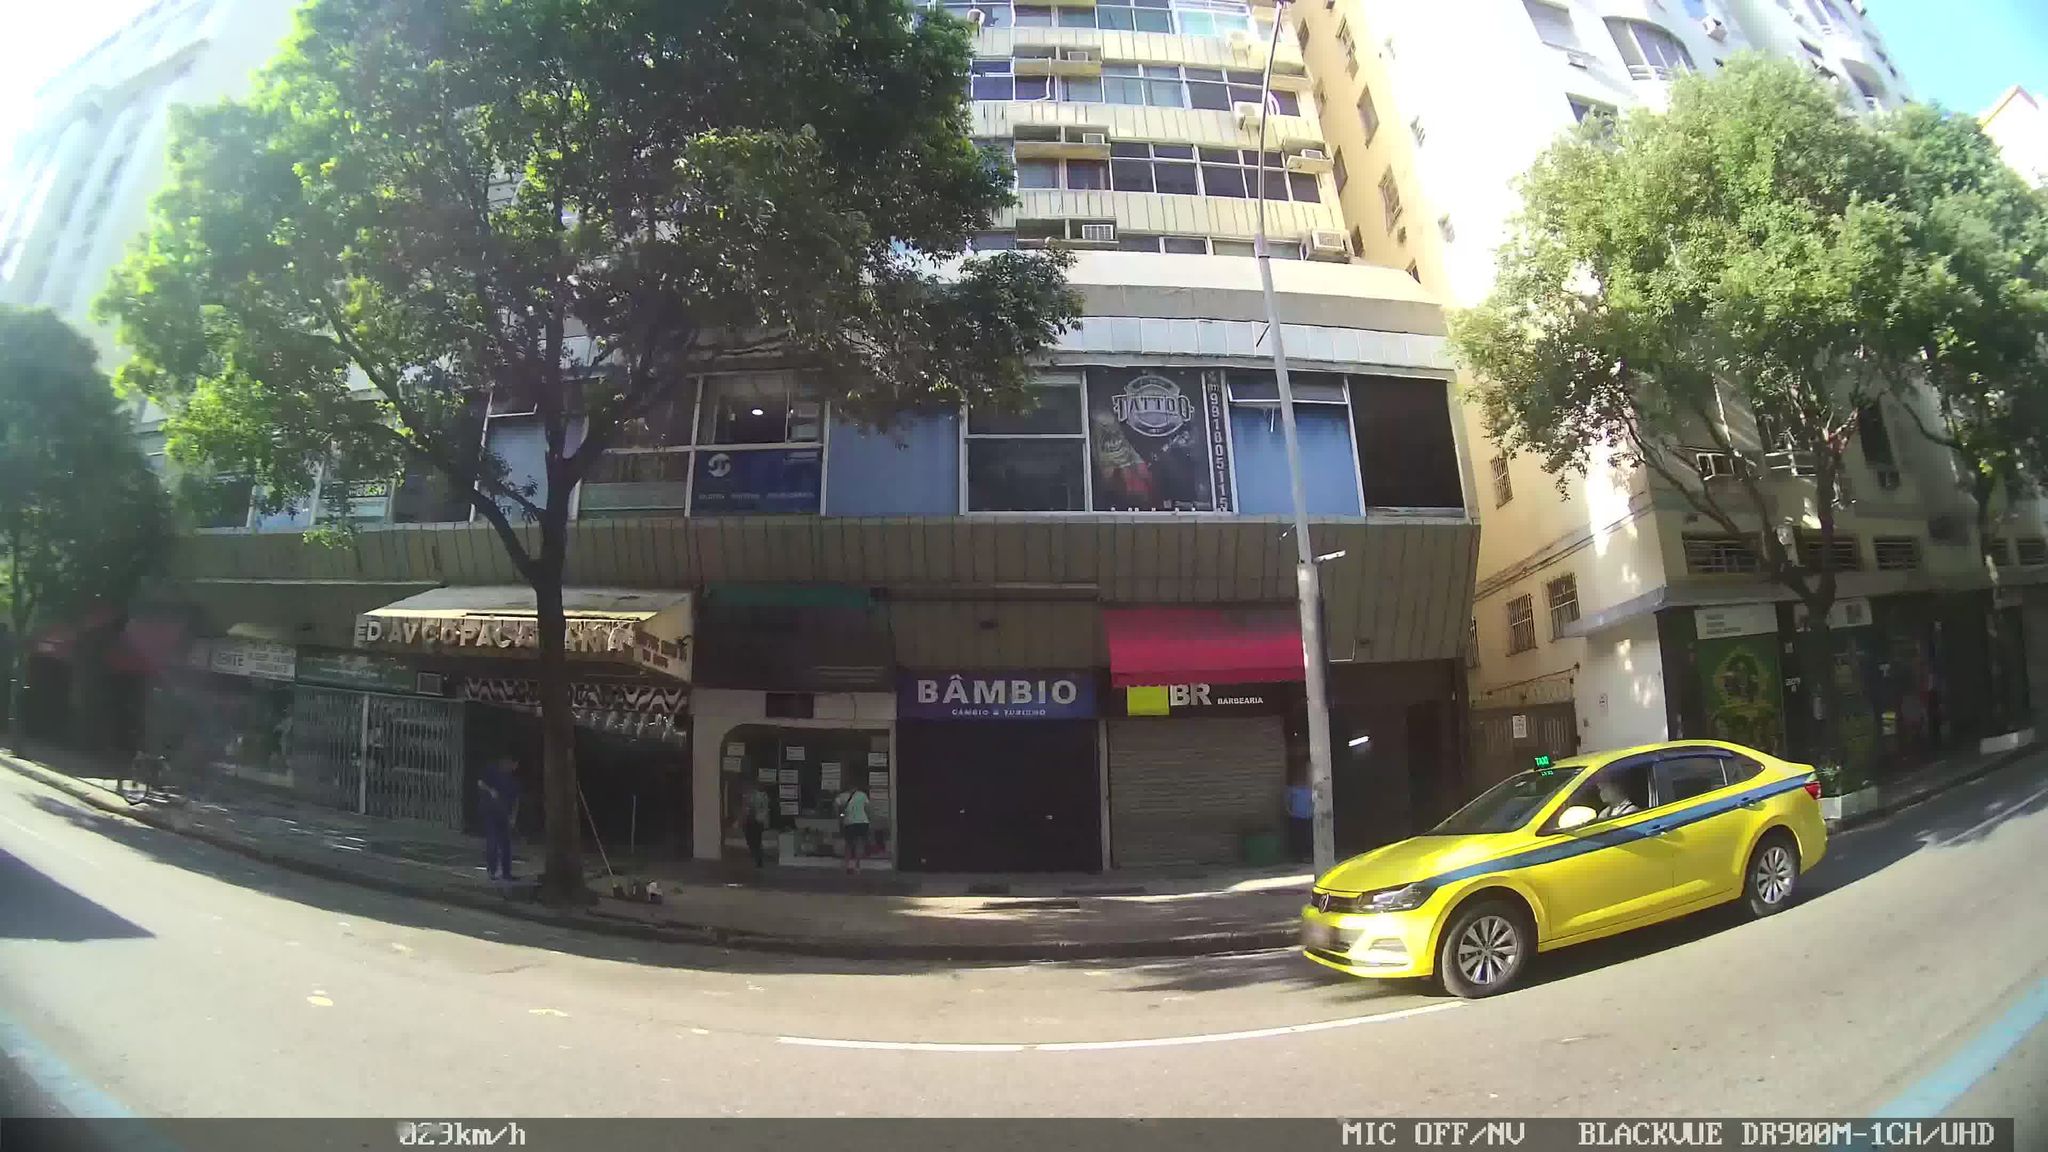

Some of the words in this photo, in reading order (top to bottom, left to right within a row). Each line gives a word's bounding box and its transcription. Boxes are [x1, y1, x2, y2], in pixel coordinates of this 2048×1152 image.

[917, 674, 1077, 704] BÂMBIO
[1170, 683, 1212, 706] BR
[1217, 697, 1264, 705] BARBEARIA
